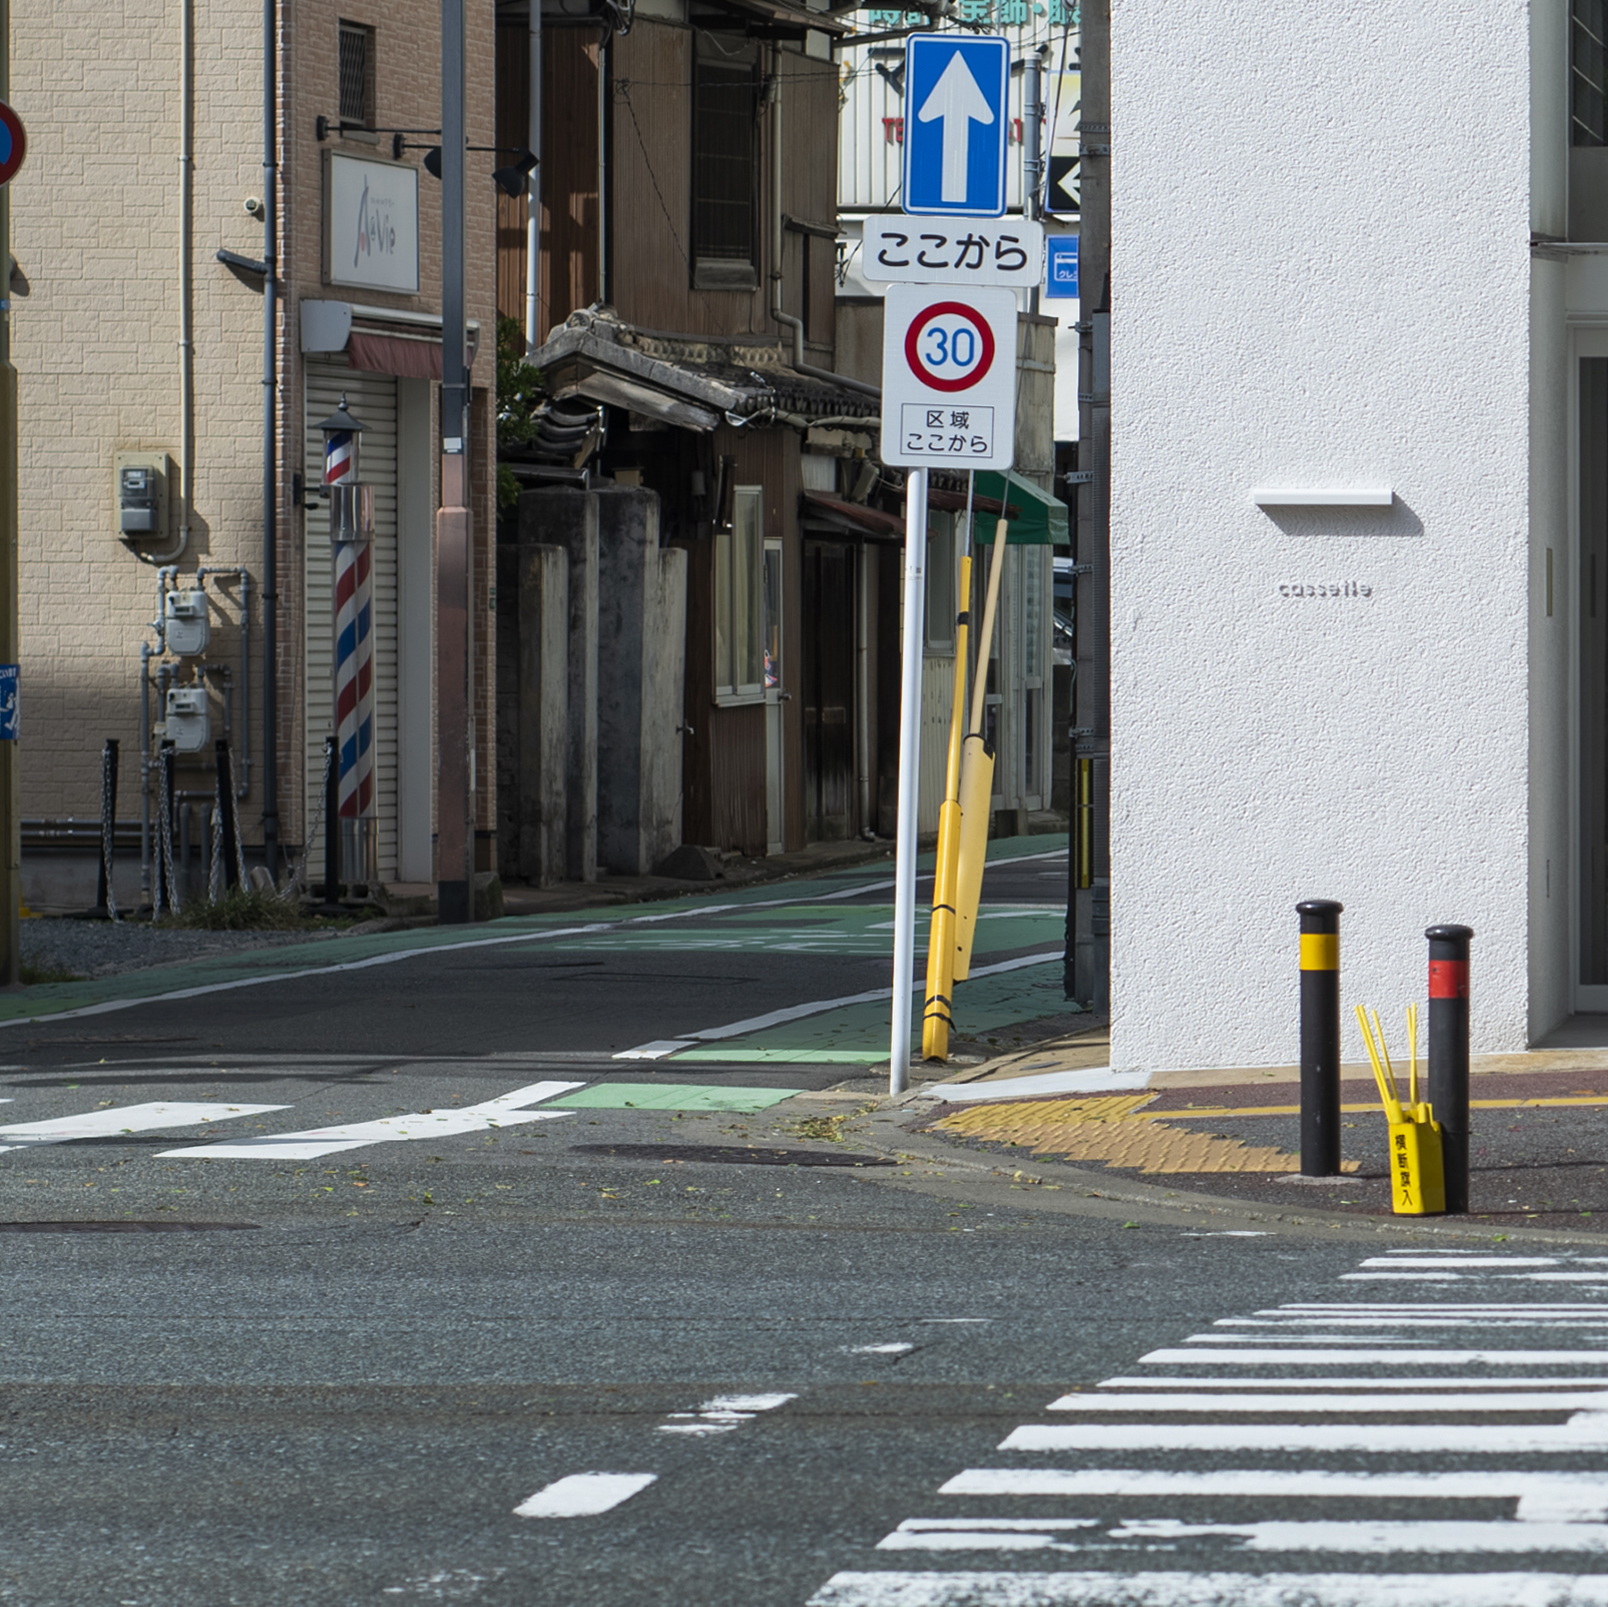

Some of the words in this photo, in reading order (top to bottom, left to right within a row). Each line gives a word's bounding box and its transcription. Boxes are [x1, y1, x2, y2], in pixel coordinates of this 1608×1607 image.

[877, 232, 1028, 271] ここから
[925, 327, 975, 367] 30
[926, 410, 970, 430] 区域
[906, 433, 988, 454] ここから
